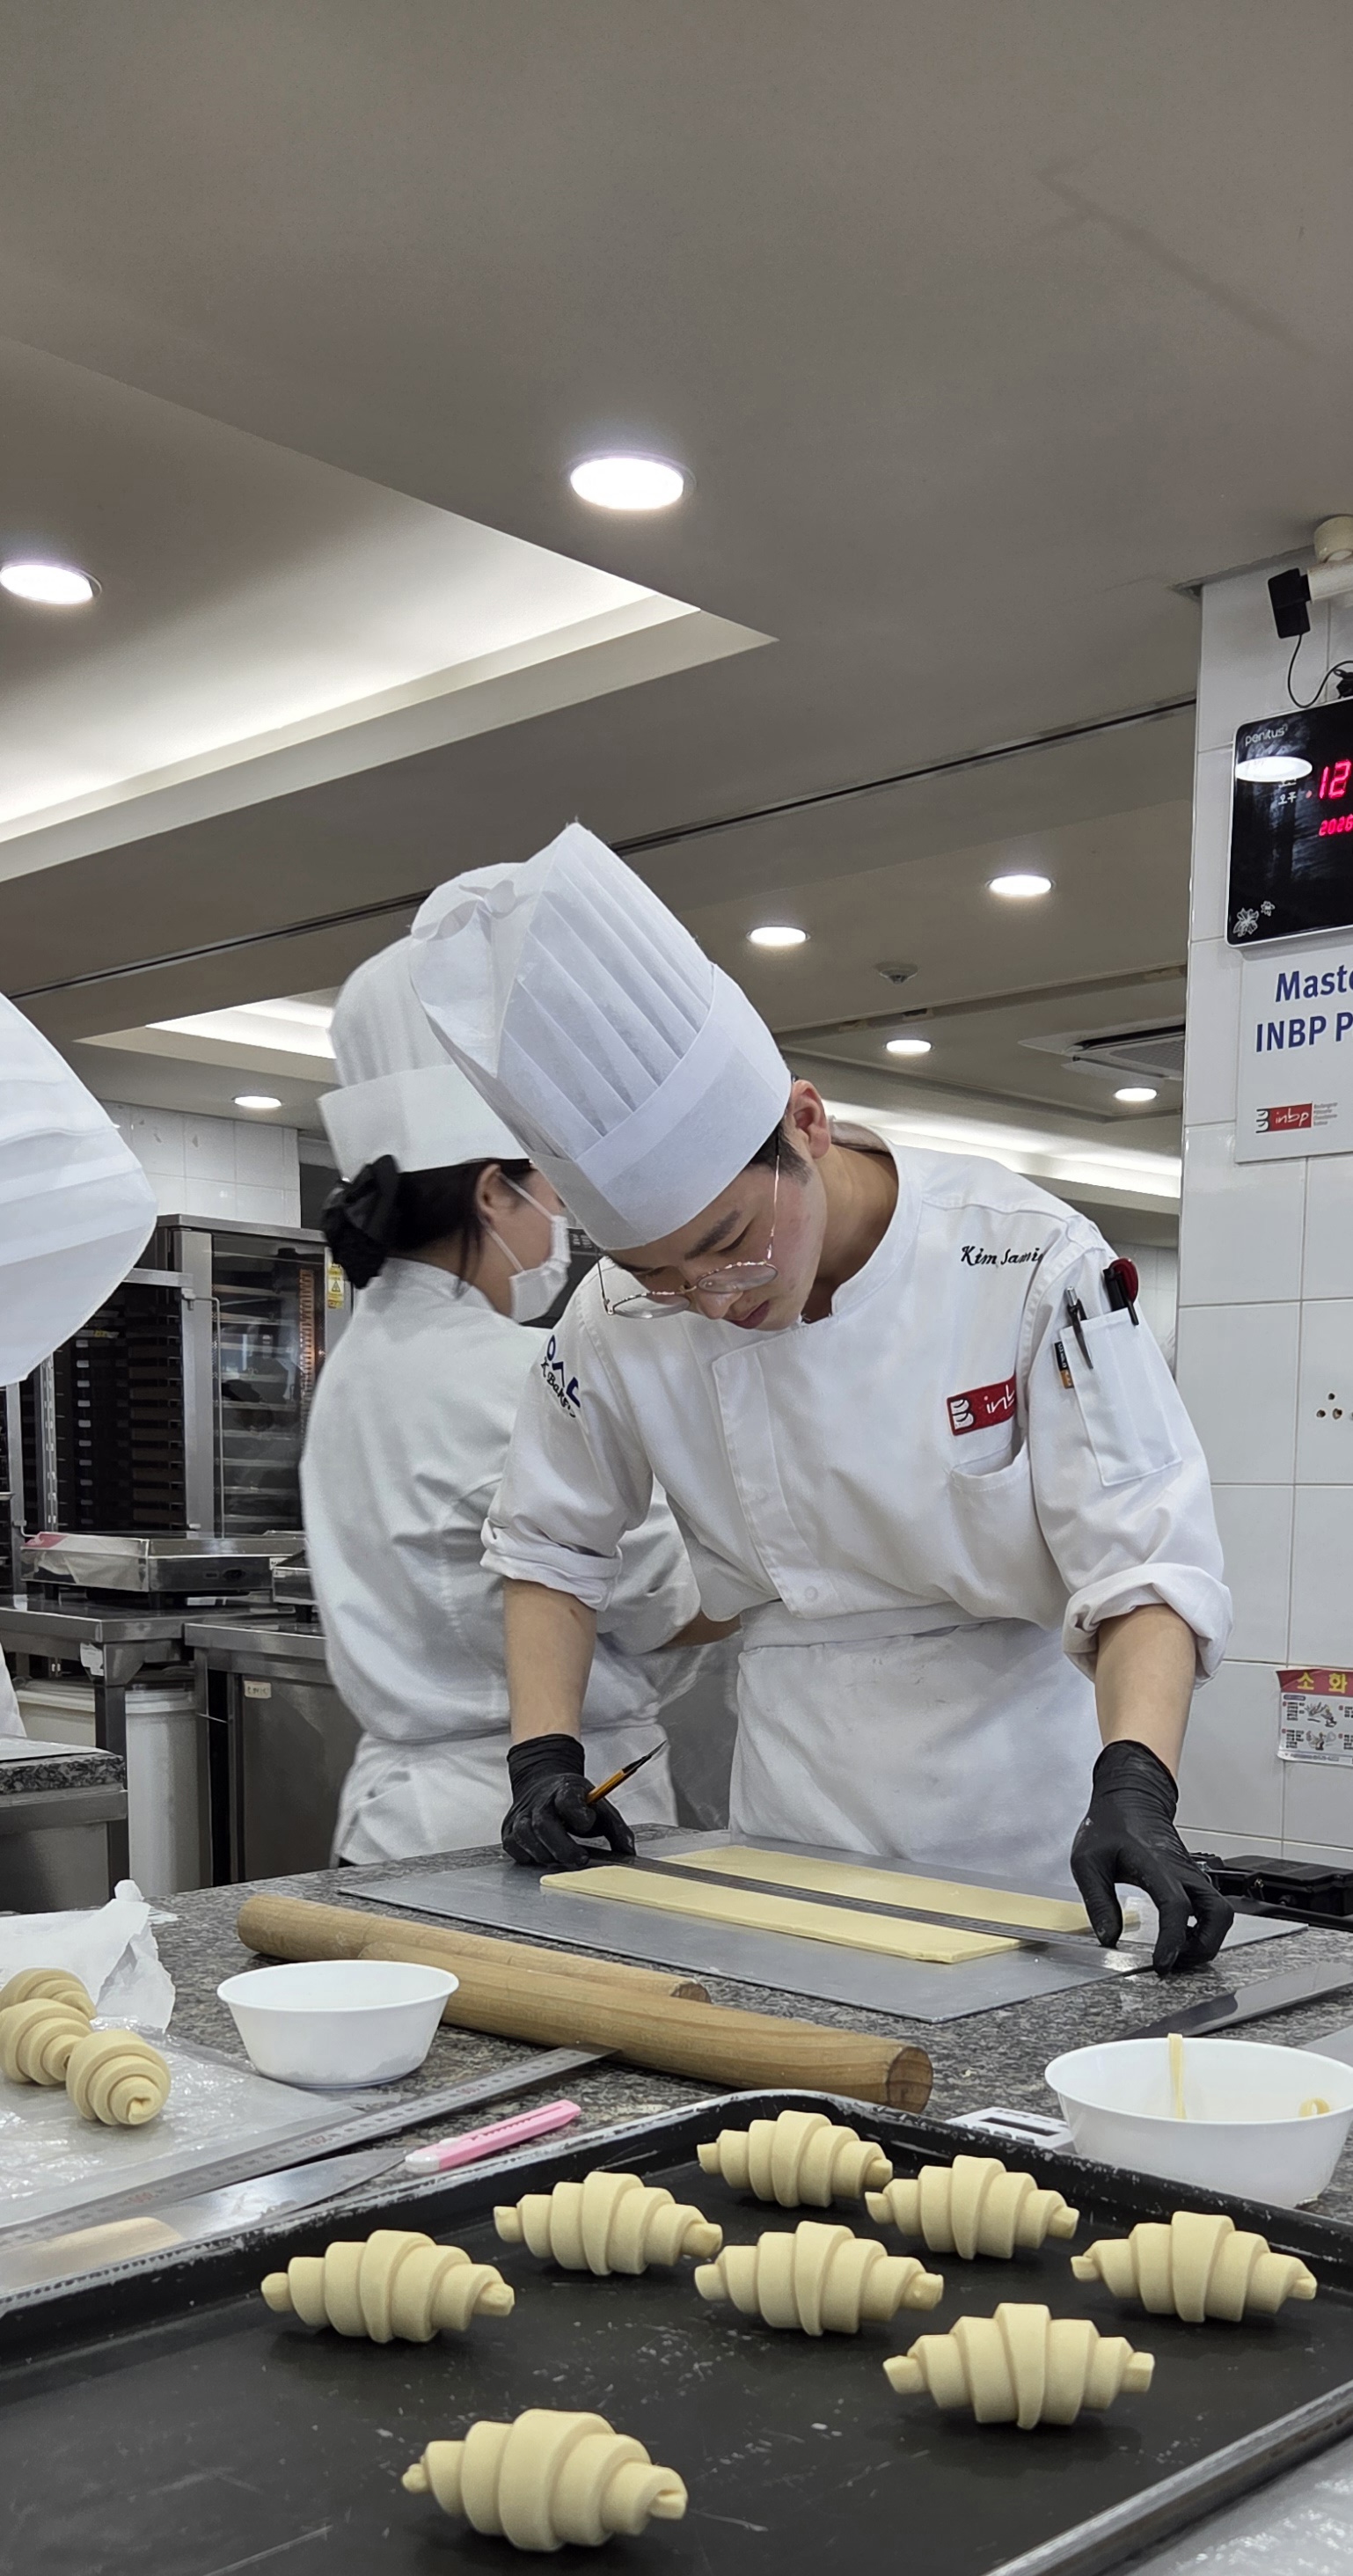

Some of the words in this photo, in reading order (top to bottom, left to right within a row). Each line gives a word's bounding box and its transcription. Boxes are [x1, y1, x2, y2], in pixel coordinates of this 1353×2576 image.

[1320, 759, 1351, 799] 12
[1256, 1015, 1327, 1053] INBP
[1276, 1108, 1309, 1126] inbp
[961, 1245, 998, 1266] Kim
